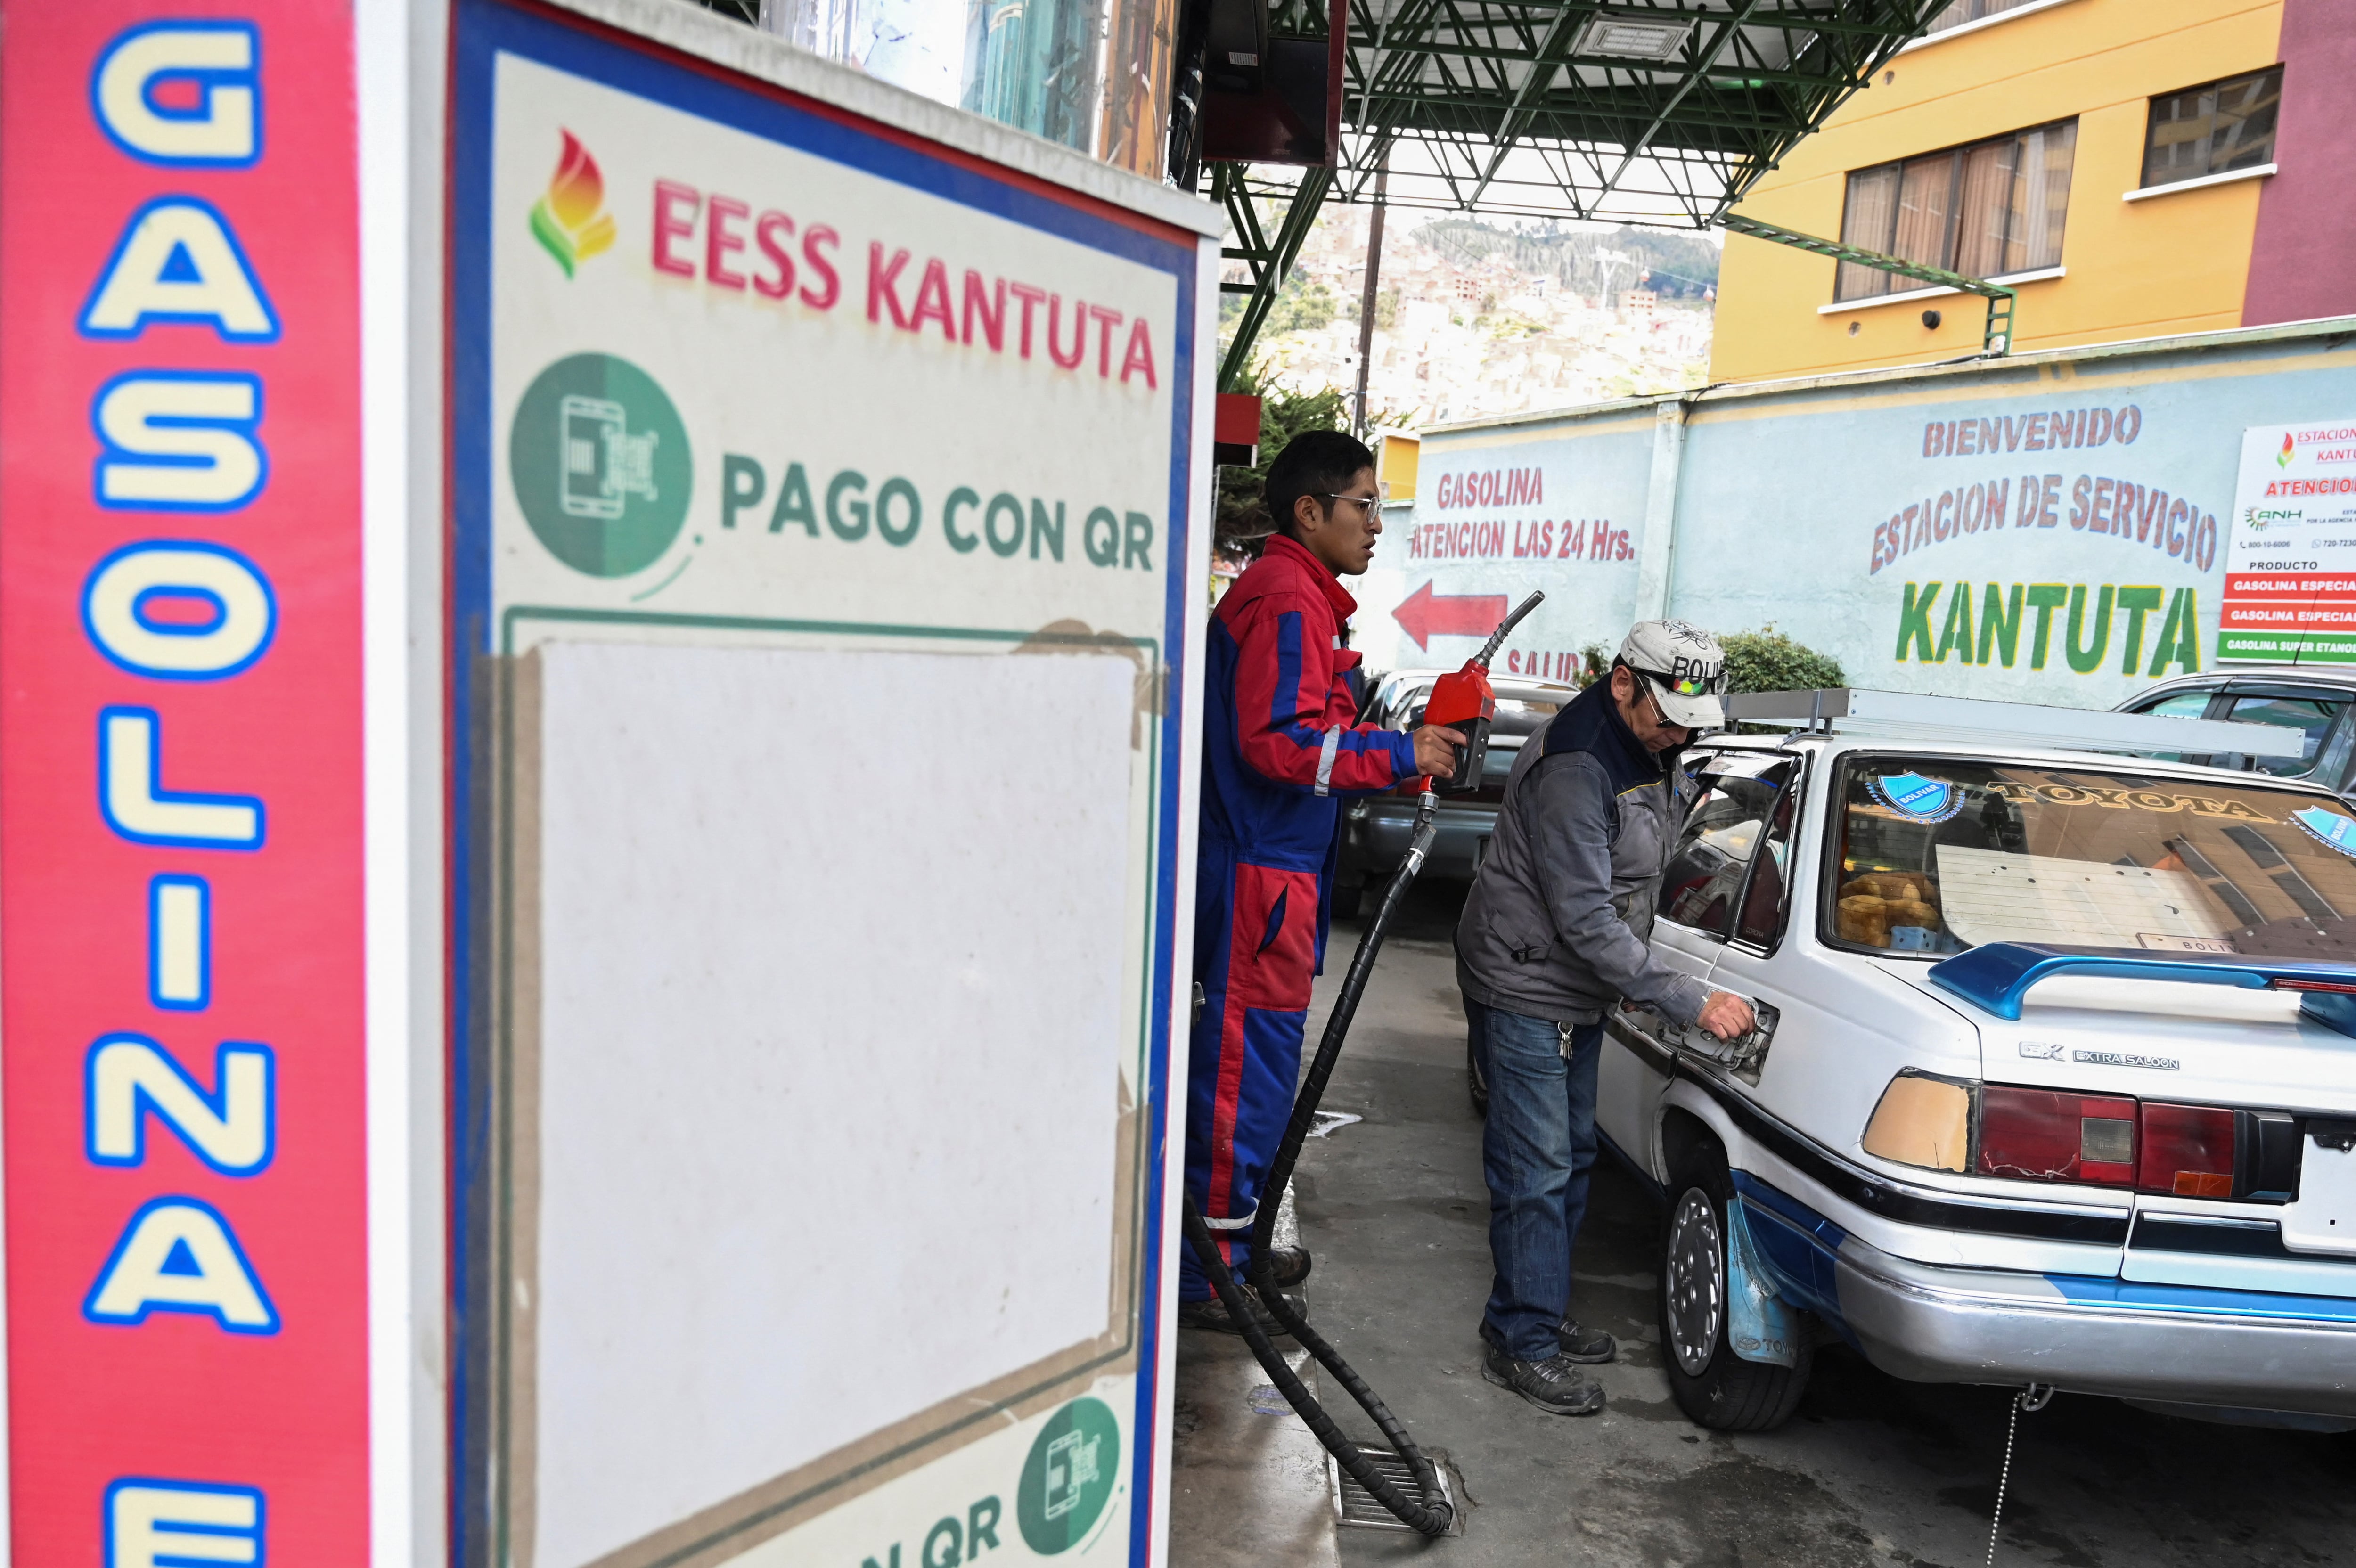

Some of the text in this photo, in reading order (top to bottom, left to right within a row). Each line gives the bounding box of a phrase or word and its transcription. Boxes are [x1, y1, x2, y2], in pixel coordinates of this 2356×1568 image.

[652, 178, 1158, 390] EESS KANTUTA
[1922, 404, 2142, 457] BIENVENIDO
[1437, 467, 1542, 508] GASOLINA
[2265, 477, 2356, 498] ATENCIO
[722, 453, 1154, 571] PAGO CON QR
[1870, 474, 2217, 575] ESTACION DE SERVICIO
[2258, 510, 2302, 519] ANH
[1410, 520, 1634, 560] ATENCION LAS 24 Hrs.
[2233, 580, 2297, 591] GASOLINA
[2250, 561, 2318, 570] PRODUCTO
[1896, 581, 2201, 678] KANTUTA
[2231, 610, 2294, 621] GASOLINA
[2227, 640, 2277, 651] GASOLINA
[2280, 642, 2314, 652] SUPER
[76, 19, 282, 1336] GASOLINA
[1898, 784, 1940, 804] BOLIVAR
[1986, 782, 2277, 824] TOYOTA
[2075, 1051, 2121, 1063] EXTRA
[2125, 1055, 2179, 1069] SALOON
[921, 1495, 1001, 1568] QR
